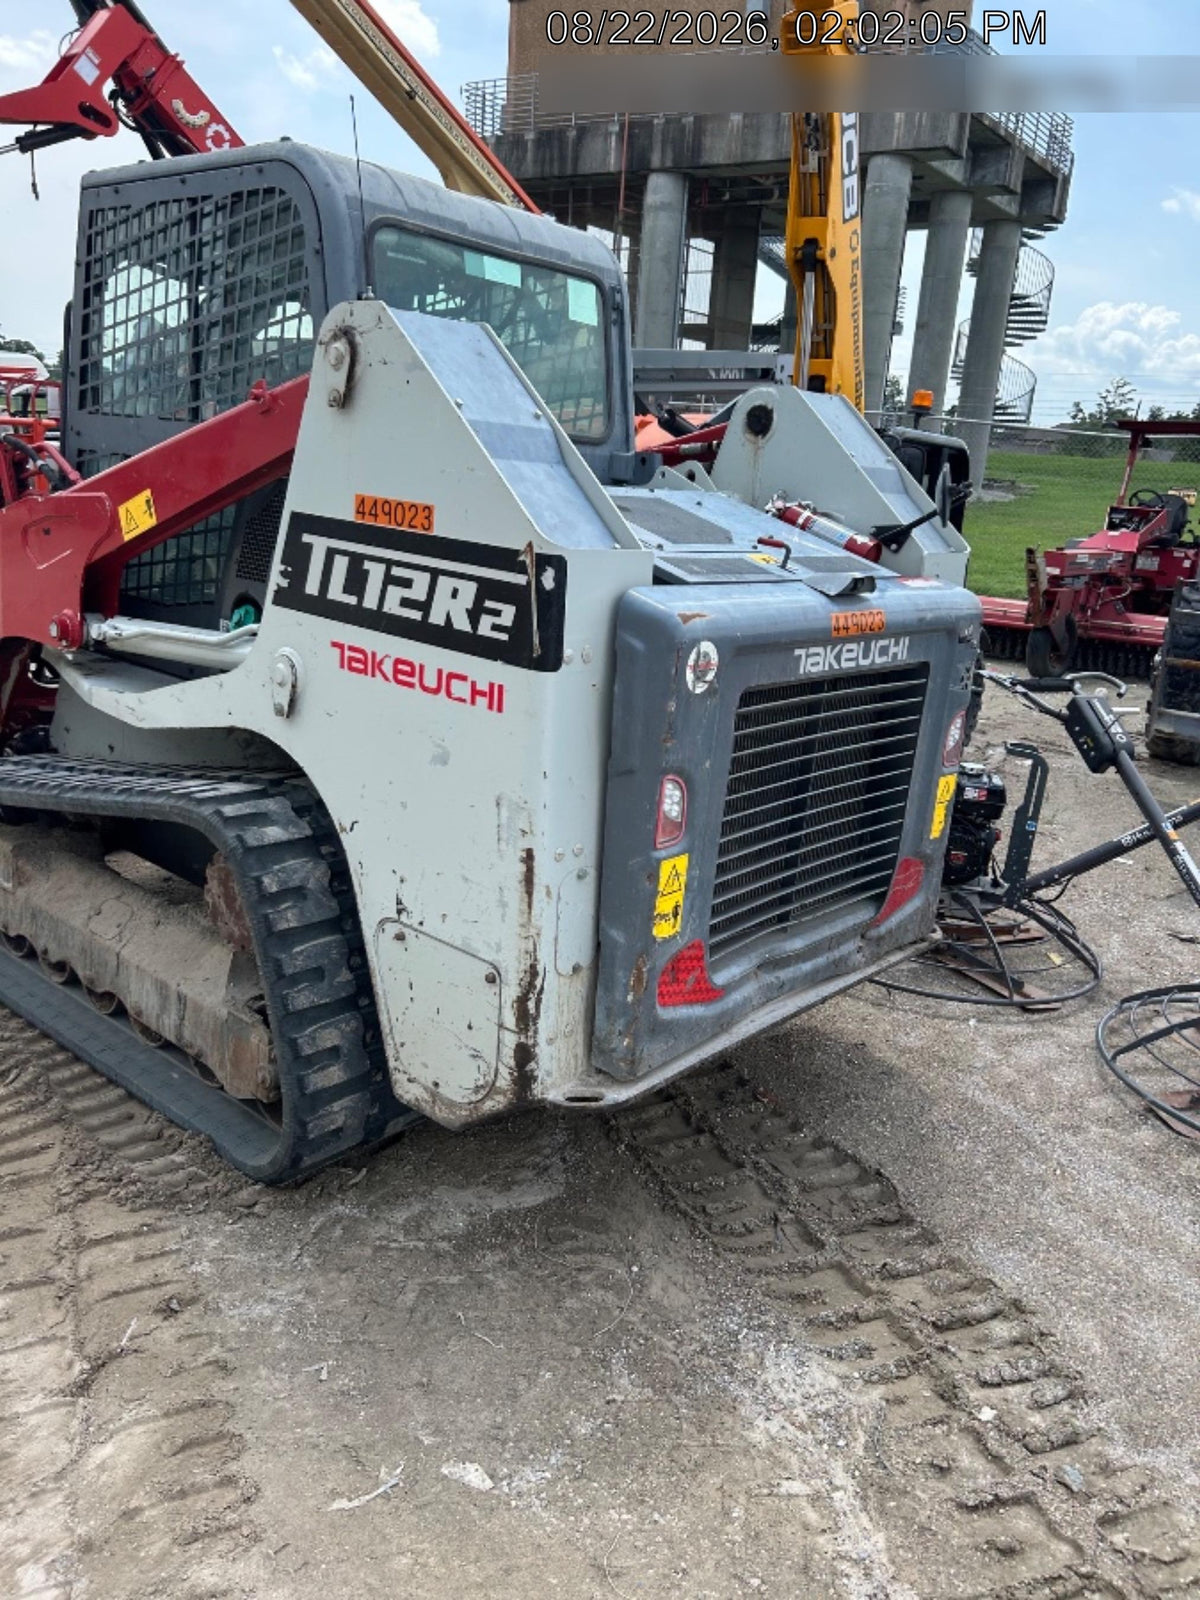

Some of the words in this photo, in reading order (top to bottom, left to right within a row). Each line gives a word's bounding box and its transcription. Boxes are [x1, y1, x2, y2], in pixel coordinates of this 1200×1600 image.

[355, 497, 433, 532] 449023
[302, 533, 528, 641] TL12R2
[833, 611, 885, 635] 449023
